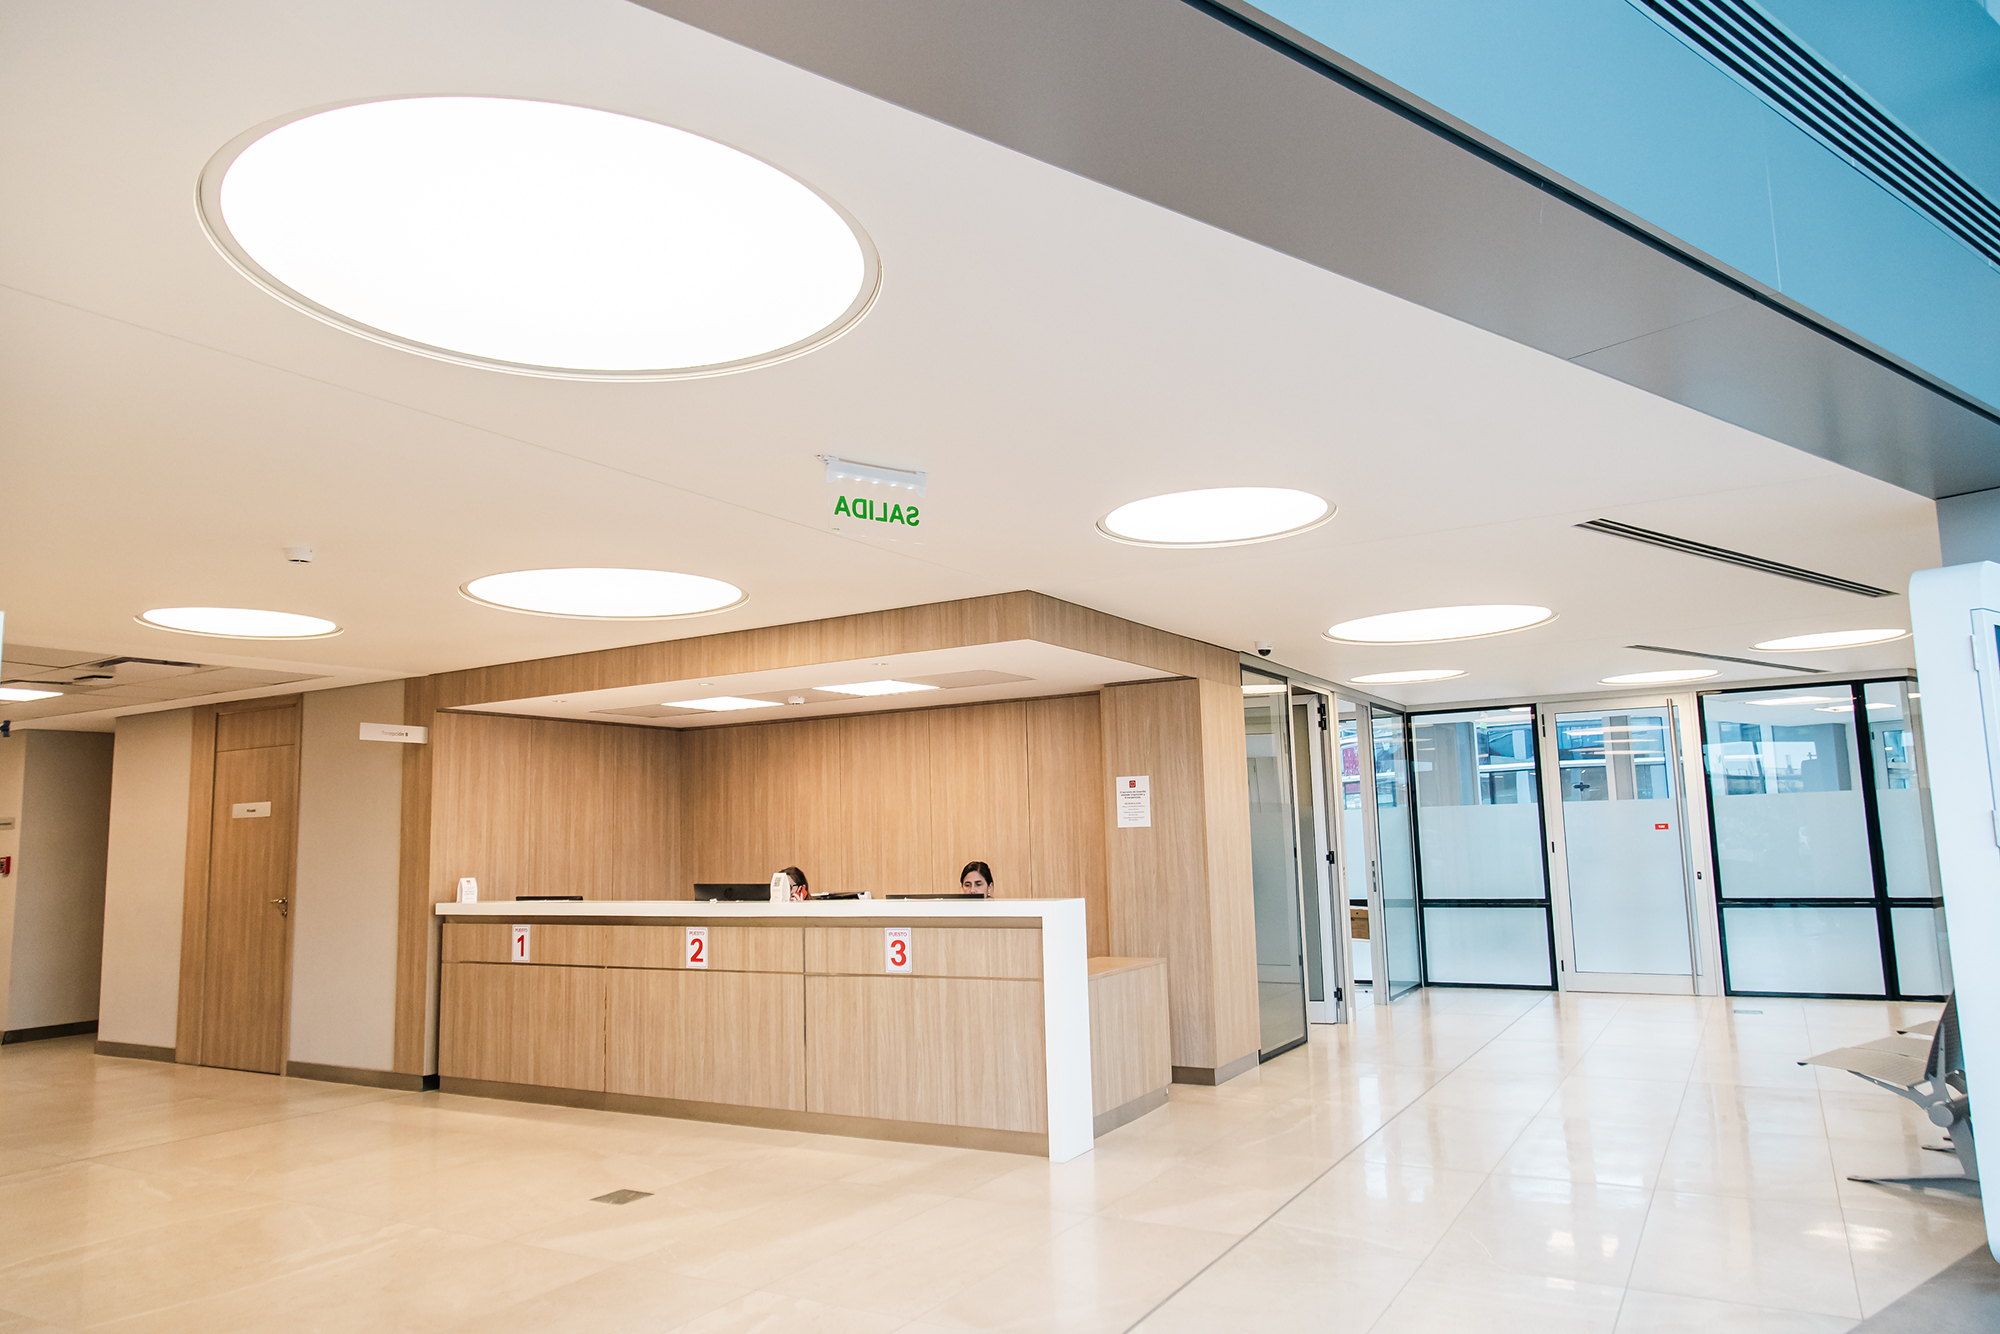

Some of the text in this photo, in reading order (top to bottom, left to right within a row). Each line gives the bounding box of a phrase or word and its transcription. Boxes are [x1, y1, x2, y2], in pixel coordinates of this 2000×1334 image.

[517, 934, 525, 957] 1
[690, 938, 704, 962] 2
[890, 939, 907, 967] 3
